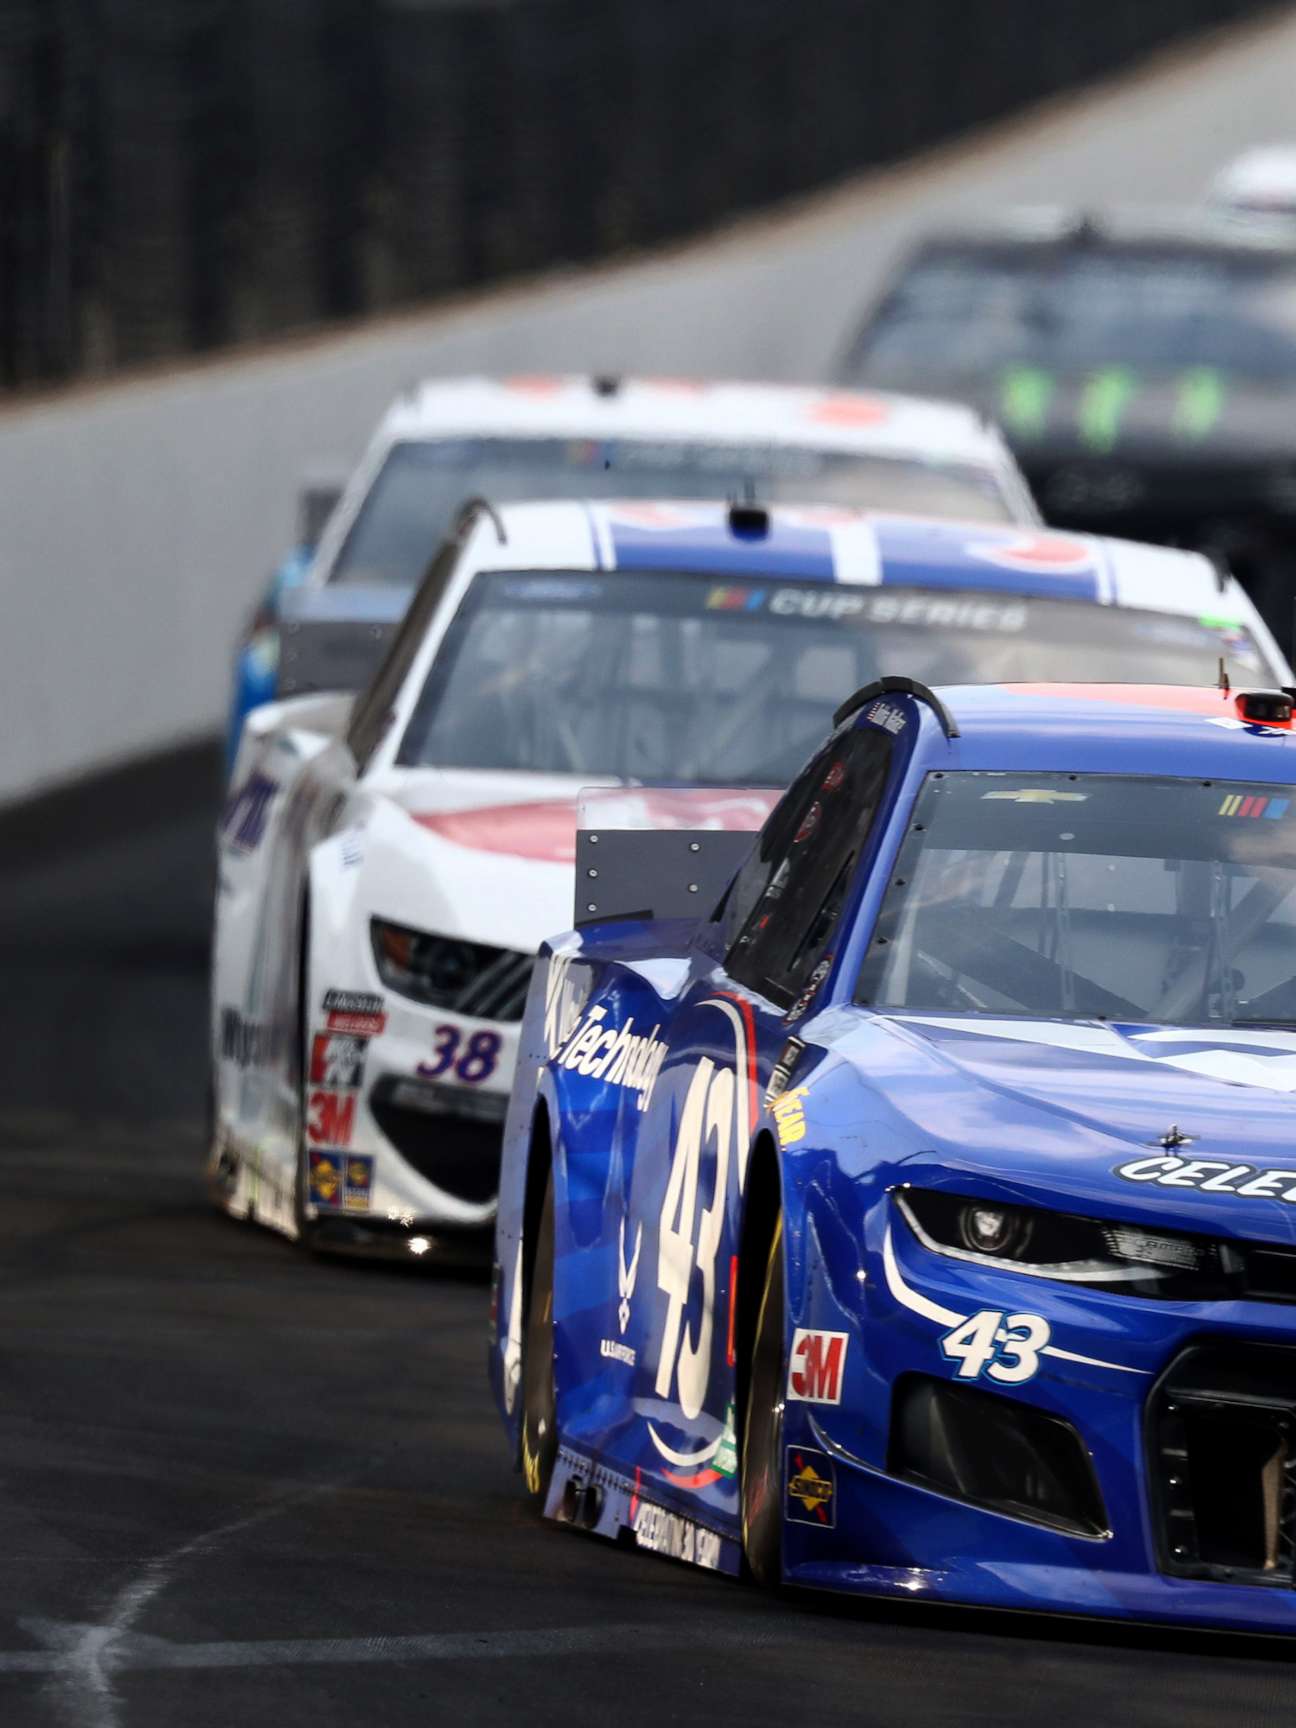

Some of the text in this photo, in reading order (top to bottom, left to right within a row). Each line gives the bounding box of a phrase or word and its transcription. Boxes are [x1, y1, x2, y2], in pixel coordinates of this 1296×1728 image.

[768, 587, 1027, 632] CUP SERIES
[416, 1023, 503, 1083] 38
[308, 1090, 358, 1146] 3M
[655, 1054, 734, 1420] 43
[791, 1333, 844, 1401] 3M
[940, 1308, 1051, 1384] 43
